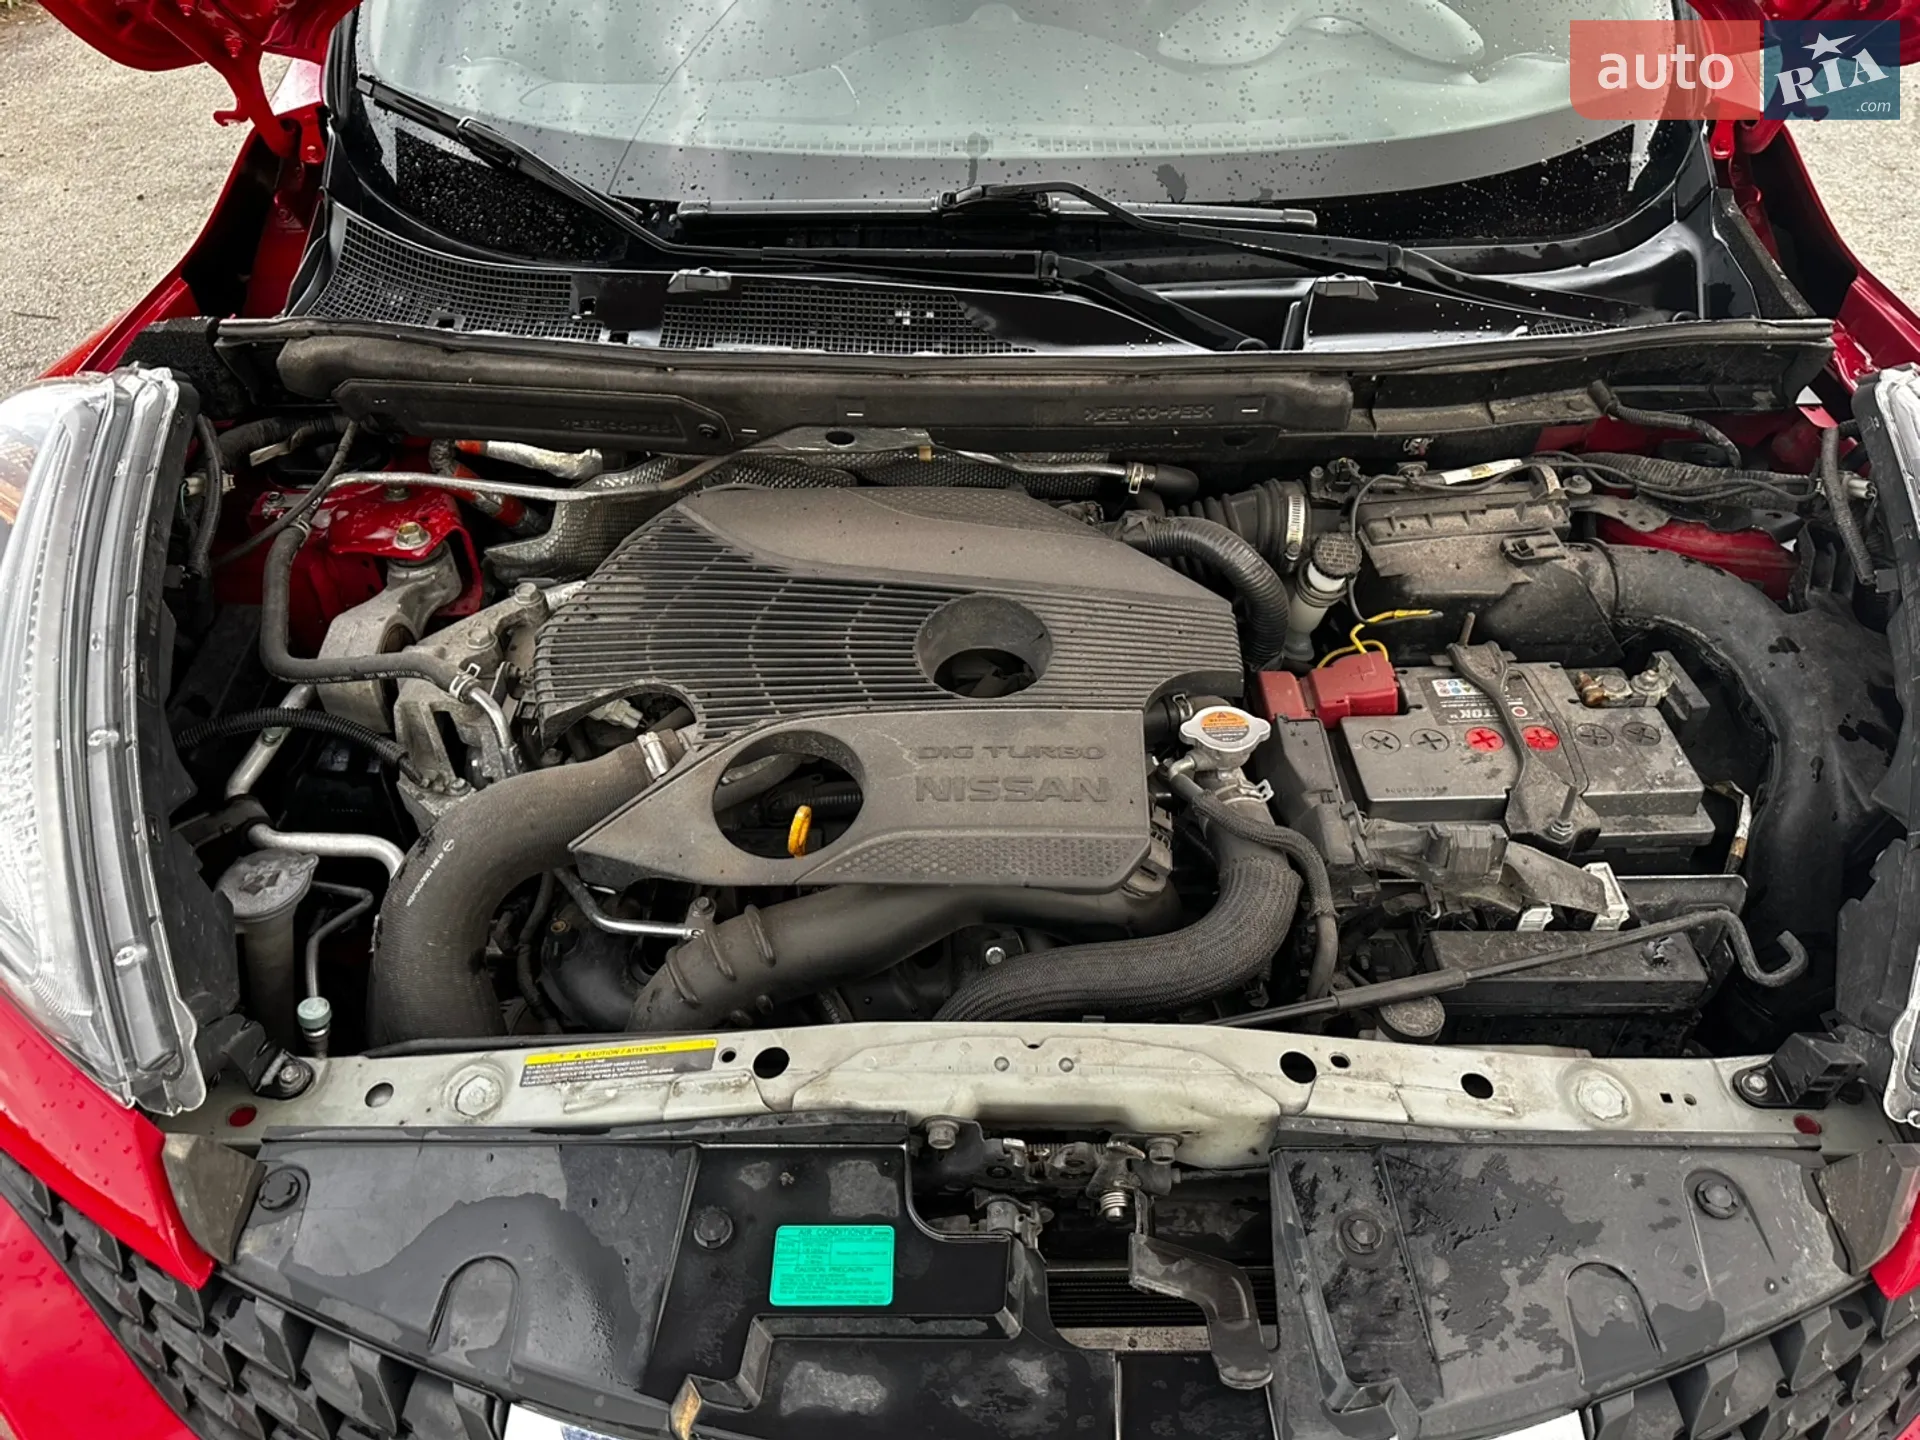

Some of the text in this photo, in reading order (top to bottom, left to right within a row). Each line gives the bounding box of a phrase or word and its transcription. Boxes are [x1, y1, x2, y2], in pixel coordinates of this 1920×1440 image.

[917, 745, 1107, 760] DIG TURBO
[915, 776, 1108, 803] NISSAN
[585, 1049, 619, 1058] CAUTION
